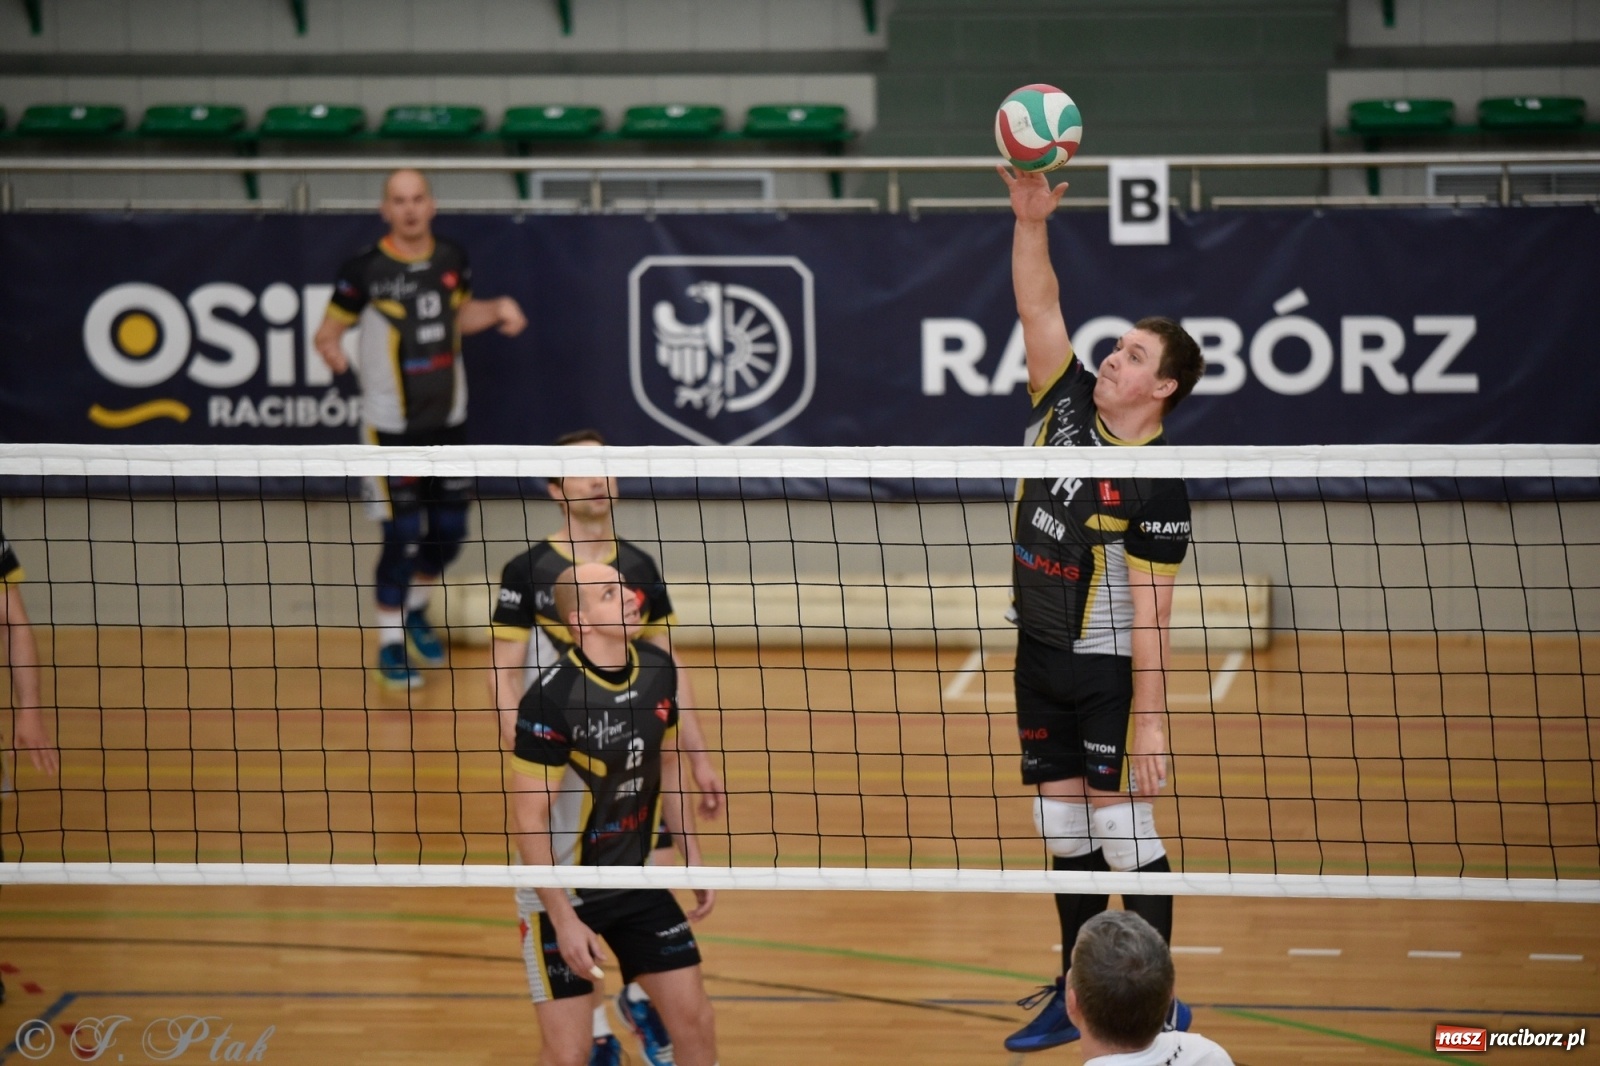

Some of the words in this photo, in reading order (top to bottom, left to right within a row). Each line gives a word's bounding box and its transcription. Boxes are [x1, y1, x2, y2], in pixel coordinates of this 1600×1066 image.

[1119, 177, 1160, 225] B
[920, 287, 1480, 396] RACBÓRZ
[207, 388, 363, 427] RACIBÓR
[1031, 506, 1067, 542] ENTER
[1139, 520, 1191, 535] GRAVTO
